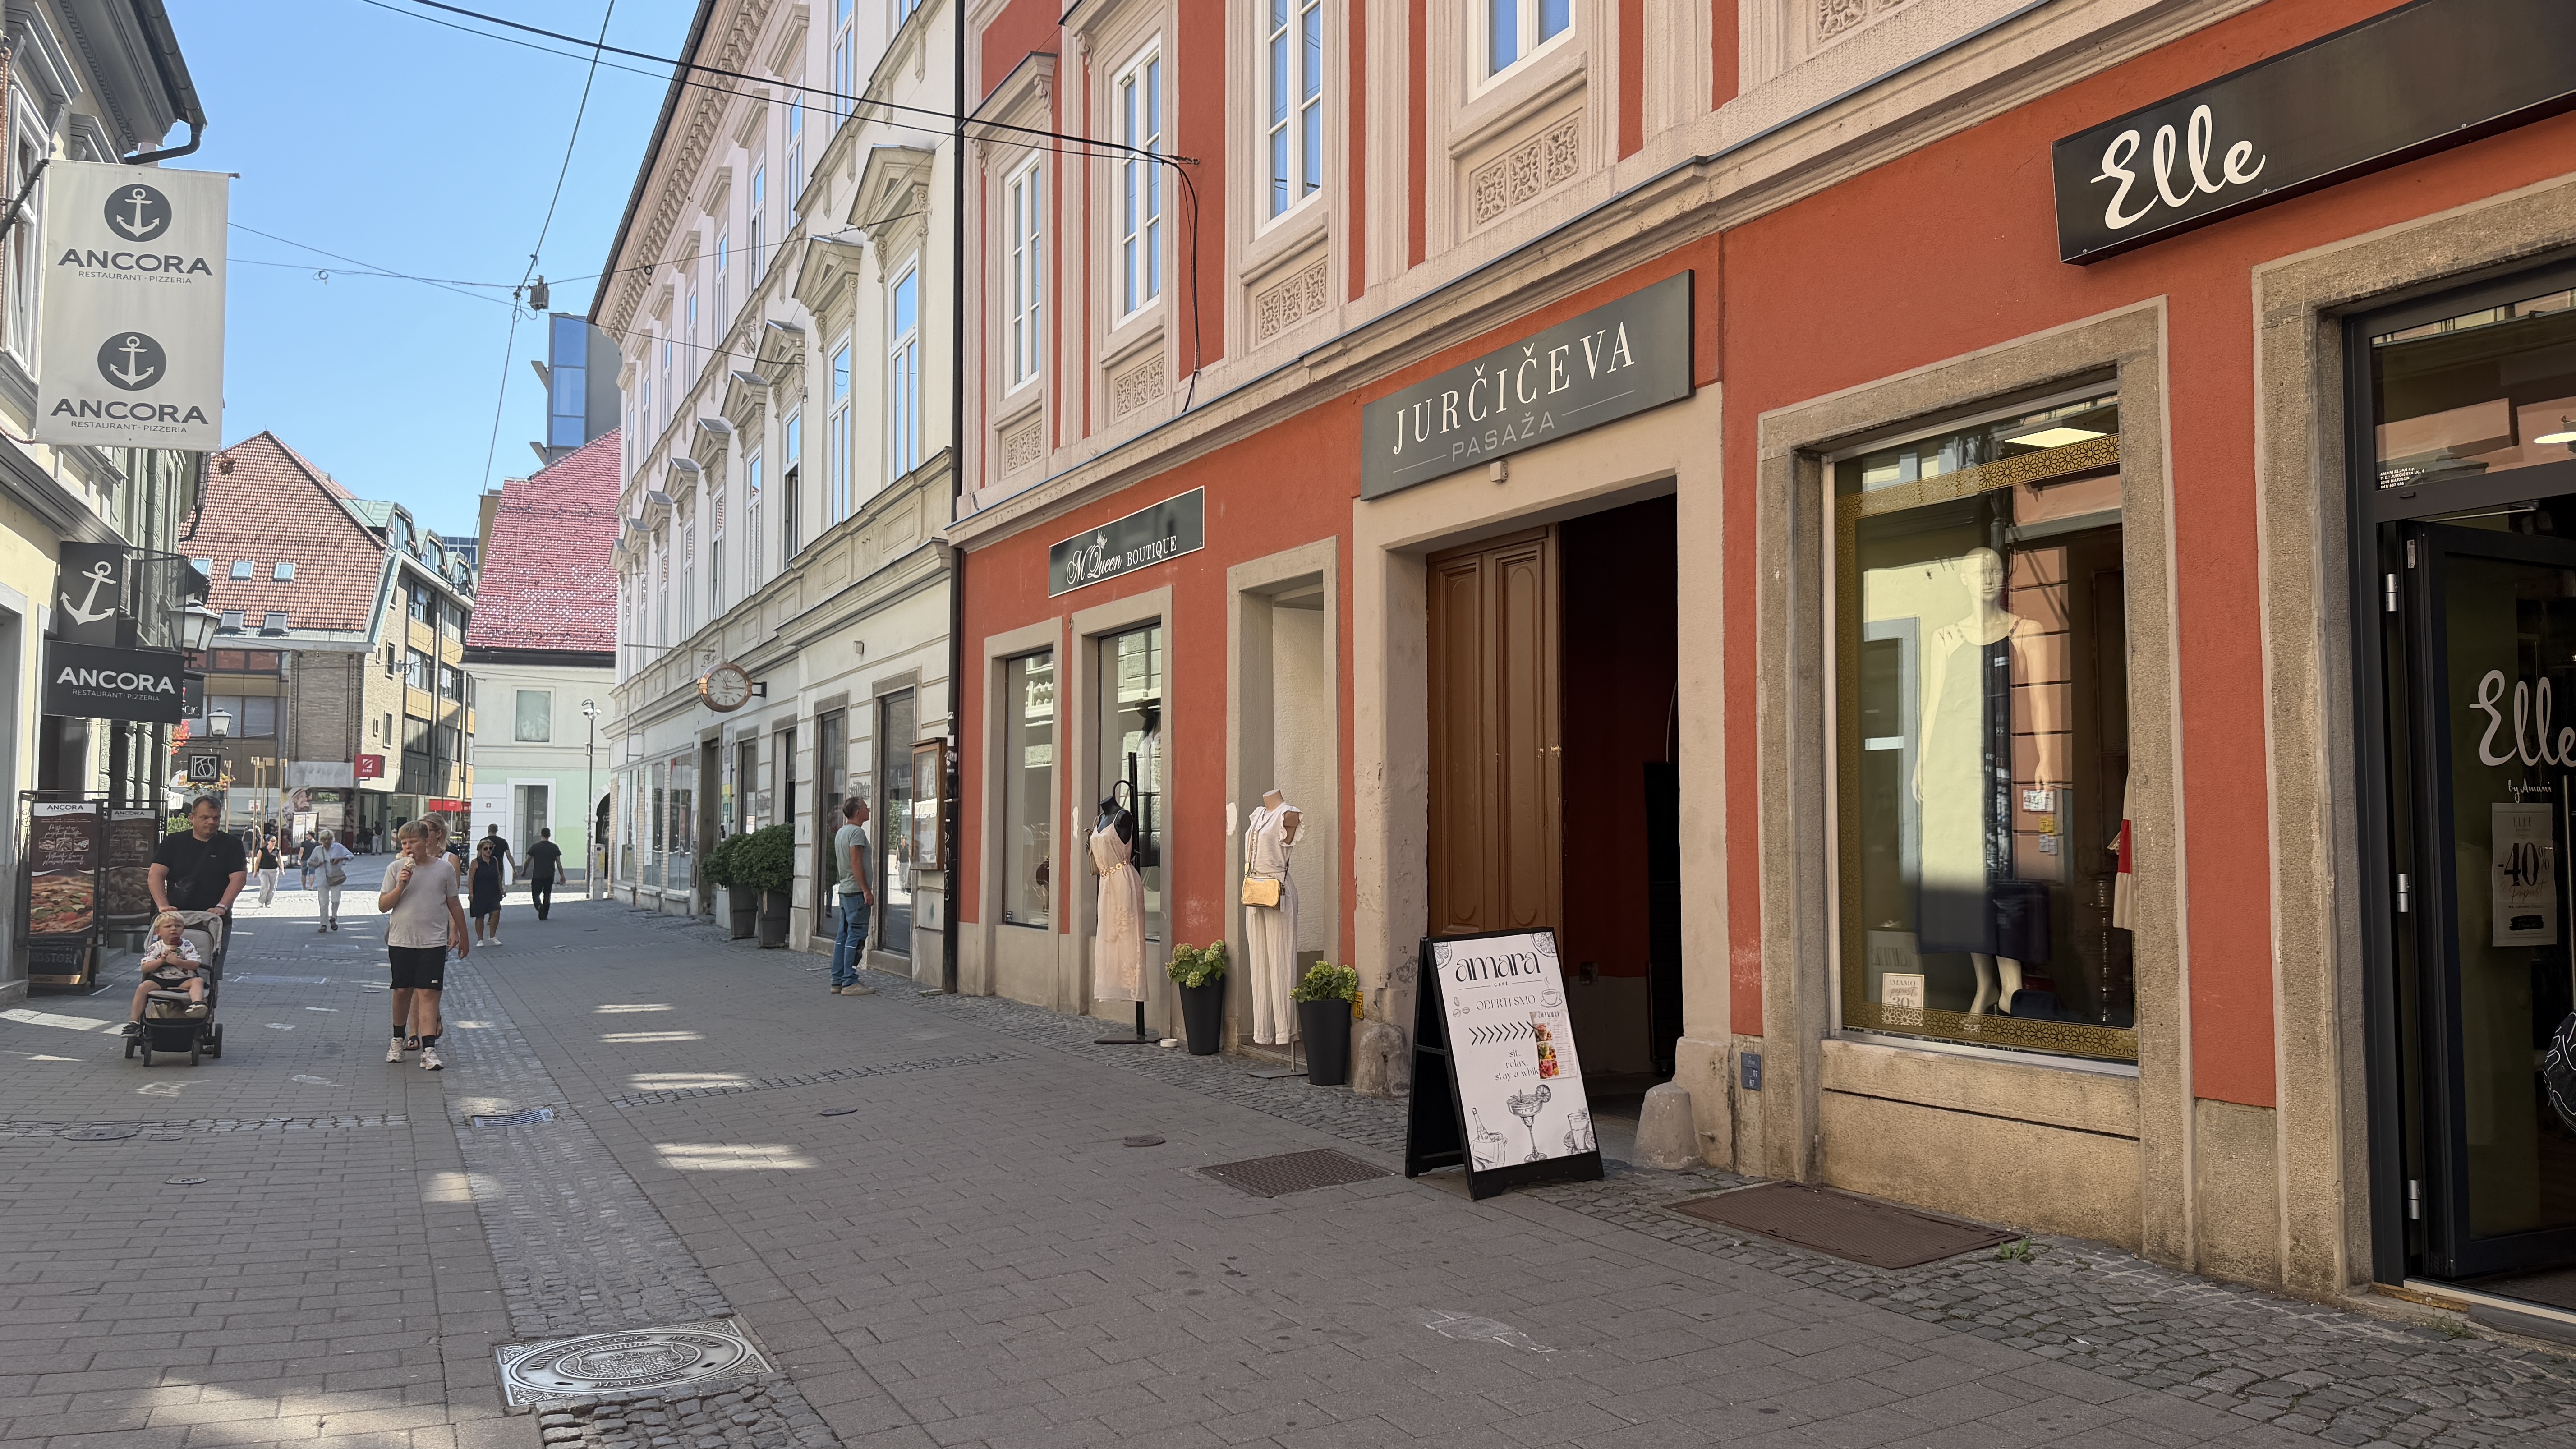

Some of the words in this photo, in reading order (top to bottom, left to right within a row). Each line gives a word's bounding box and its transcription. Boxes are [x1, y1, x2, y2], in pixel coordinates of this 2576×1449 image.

[2090, 104, 2266, 230] Elle
[57, 248, 213, 276] ANCORA
[78, 271, 143, 281] RESTAURANT
[149, 275, 192, 284] PIZZERIA
[1393, 321, 1635, 455] JURČIČEVA
[50, 398, 209, 425] ANCORA
[71, 420, 138, 430] RESTAURANT
[143, 425, 187, 433] PIZZERIA
[1452, 411, 1555, 462] PASAŽA
[1087, 545, 1122, 578] Queen
[1127, 535, 1177, 567] BOUTIQUE
[56, 667, 175, 694] ANCORA
[73, 689, 123, 699] RESTAURANT
[2469, 669, 2576, 767] Elle
[2508, 779, 2520, 803] by
[2520, 778, 2552, 793] Amani
[2513, 816, 2532, 827] ELLE
[1455, 952, 1541, 982] amara
[1476, 998, 1511, 1010] ODPRTI
[1514, 994, 1536, 1006] SMO
[1890, 986, 1918, 998] popust
[1506, 1059, 1528, 1069] relax.
[1495, 1072, 1511, 1081] stay
[667, 1335, 721, 1347] MESTO
[592, 1371, 690, 1388] MARIBOR
